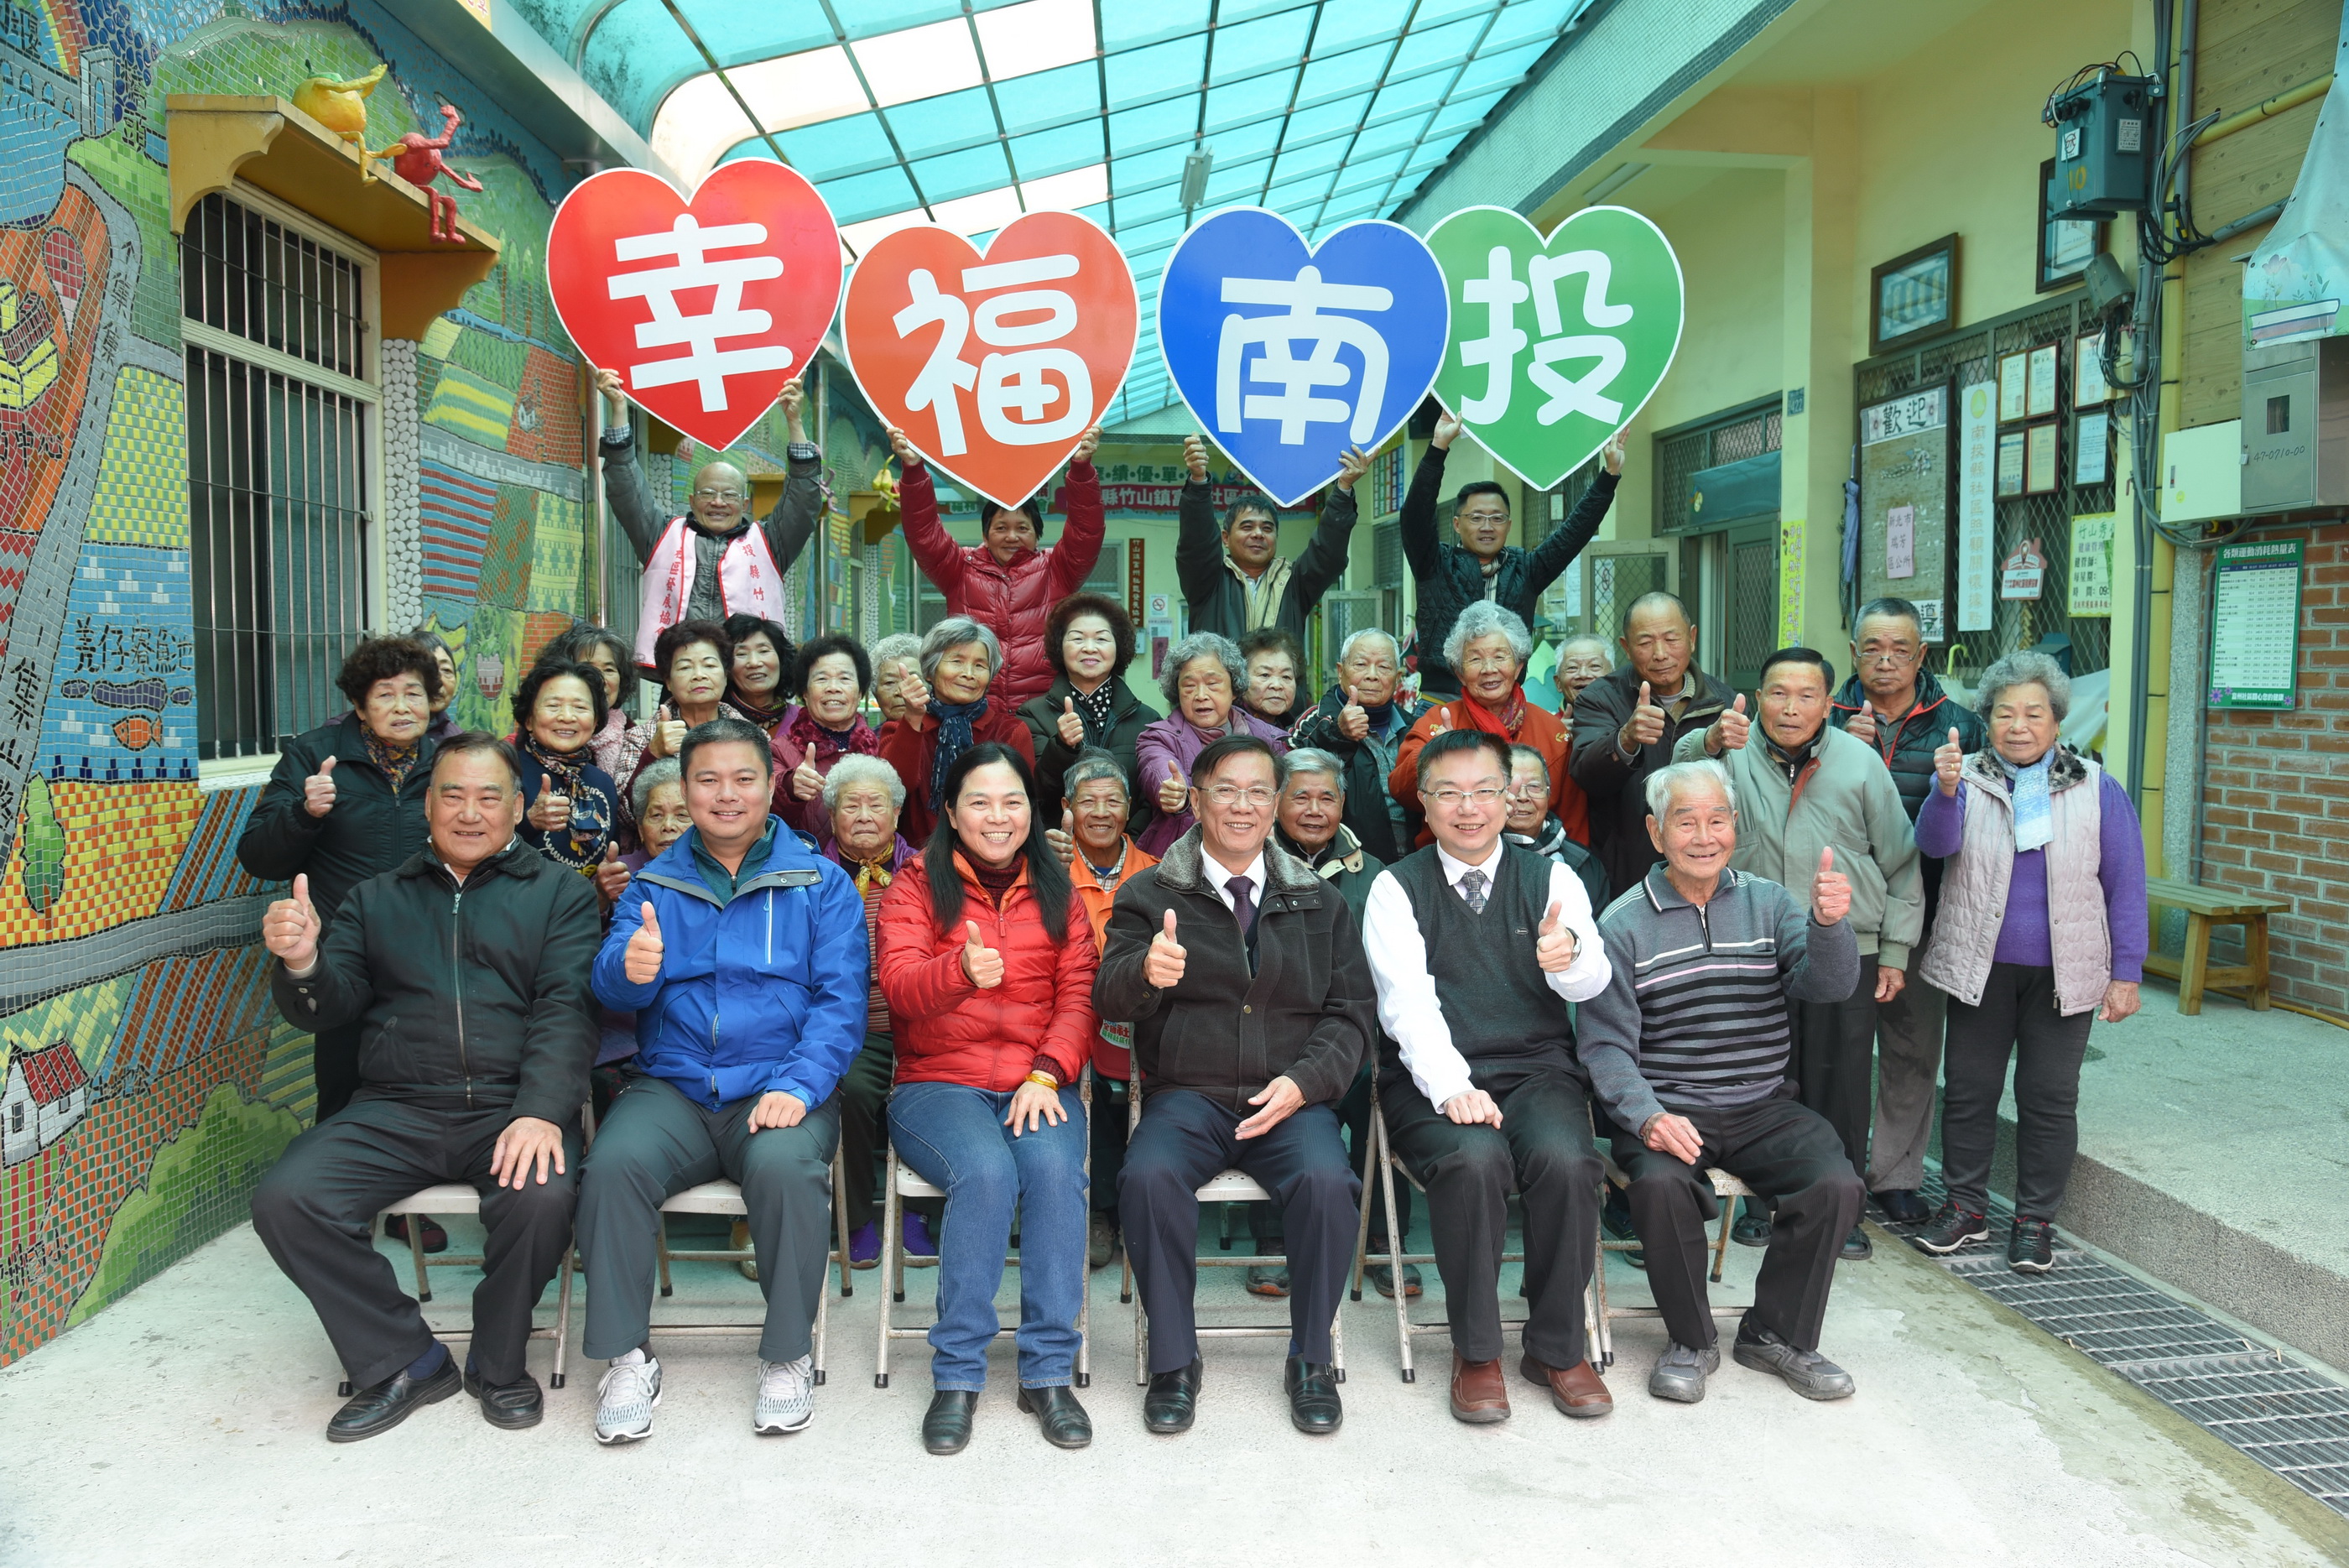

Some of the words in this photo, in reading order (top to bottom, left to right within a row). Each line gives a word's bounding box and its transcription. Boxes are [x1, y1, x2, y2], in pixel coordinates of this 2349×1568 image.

[607, 212, 793, 412] 幸
[893, 254, 1093, 456] 福
[1216, 265, 1393, 445] 南
[1460, 246, 1633, 426] 投
[1882, 397, 1927, 436] 歡迎
[0, 421, 63, 472] 中心
[1888, 513, 1912, 528] 新北市
[1891, 534, 1907, 549] 瑞芳
[1888, 555, 1911, 570] 區公所
[2223, 543, 2297, 560] 各類運動消耗熱量表
